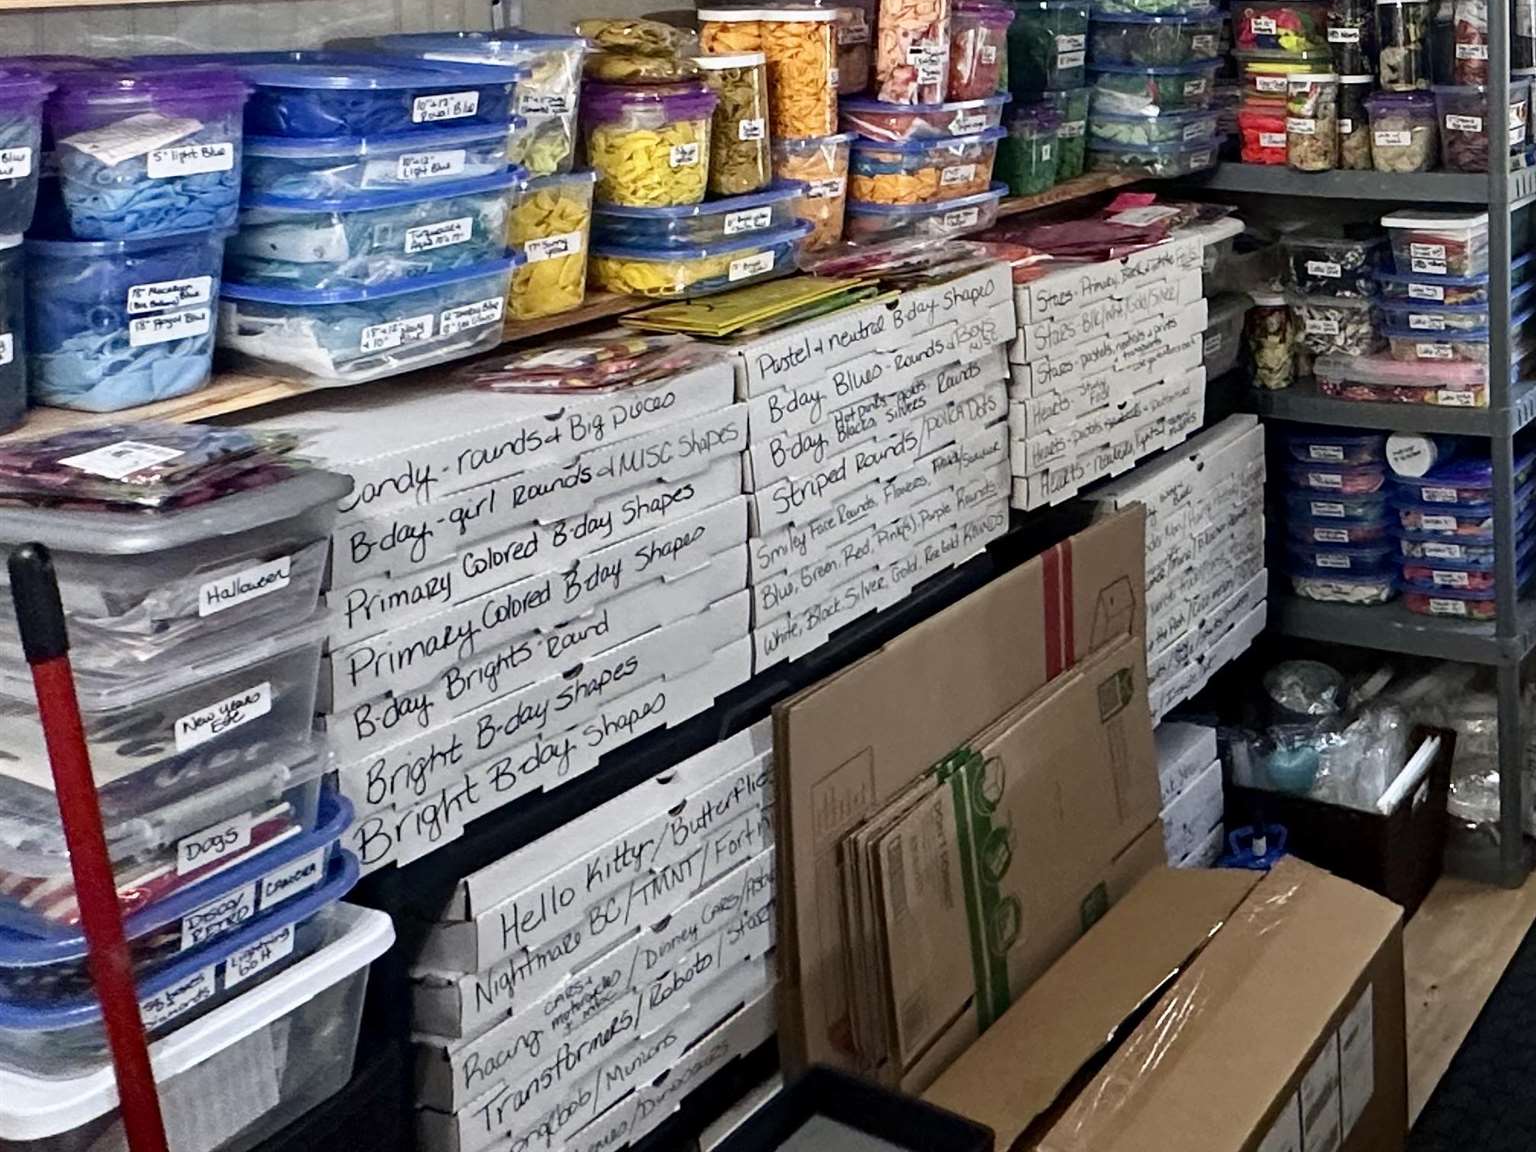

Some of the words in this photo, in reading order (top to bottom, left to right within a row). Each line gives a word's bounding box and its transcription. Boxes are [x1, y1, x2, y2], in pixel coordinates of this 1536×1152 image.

[201, 146, 226, 159] Blue
[768, 387, 827, 425] B-day
[457, 427, 543, 476] rounds
[566, 412, 605, 442] Big
[768, 432, 829, 469] B-day
[350, 520, 434, 564] B-day
[512, 462, 593, 509] Rounds
[772, 456, 847, 516] Striped
[462, 531, 539, 578] Colored
[552, 511, 613, 548] B-day
[206, 568, 290, 605] Halloween
[482, 580, 551, 629] Colored
[353, 692, 434, 741] B-day
[441, 640, 532, 701] Brights
[182, 712, 215, 735] New
[365, 733, 464, 805] Bright
[477, 696, 549, 750] B-day
[353, 774, 481, 865] Bright
[486, 737, 577, 793] B-day
[185, 826, 239, 862] Dogs
[500, 884, 576, 950] Hello
[461, 1028, 544, 1091] Racing
